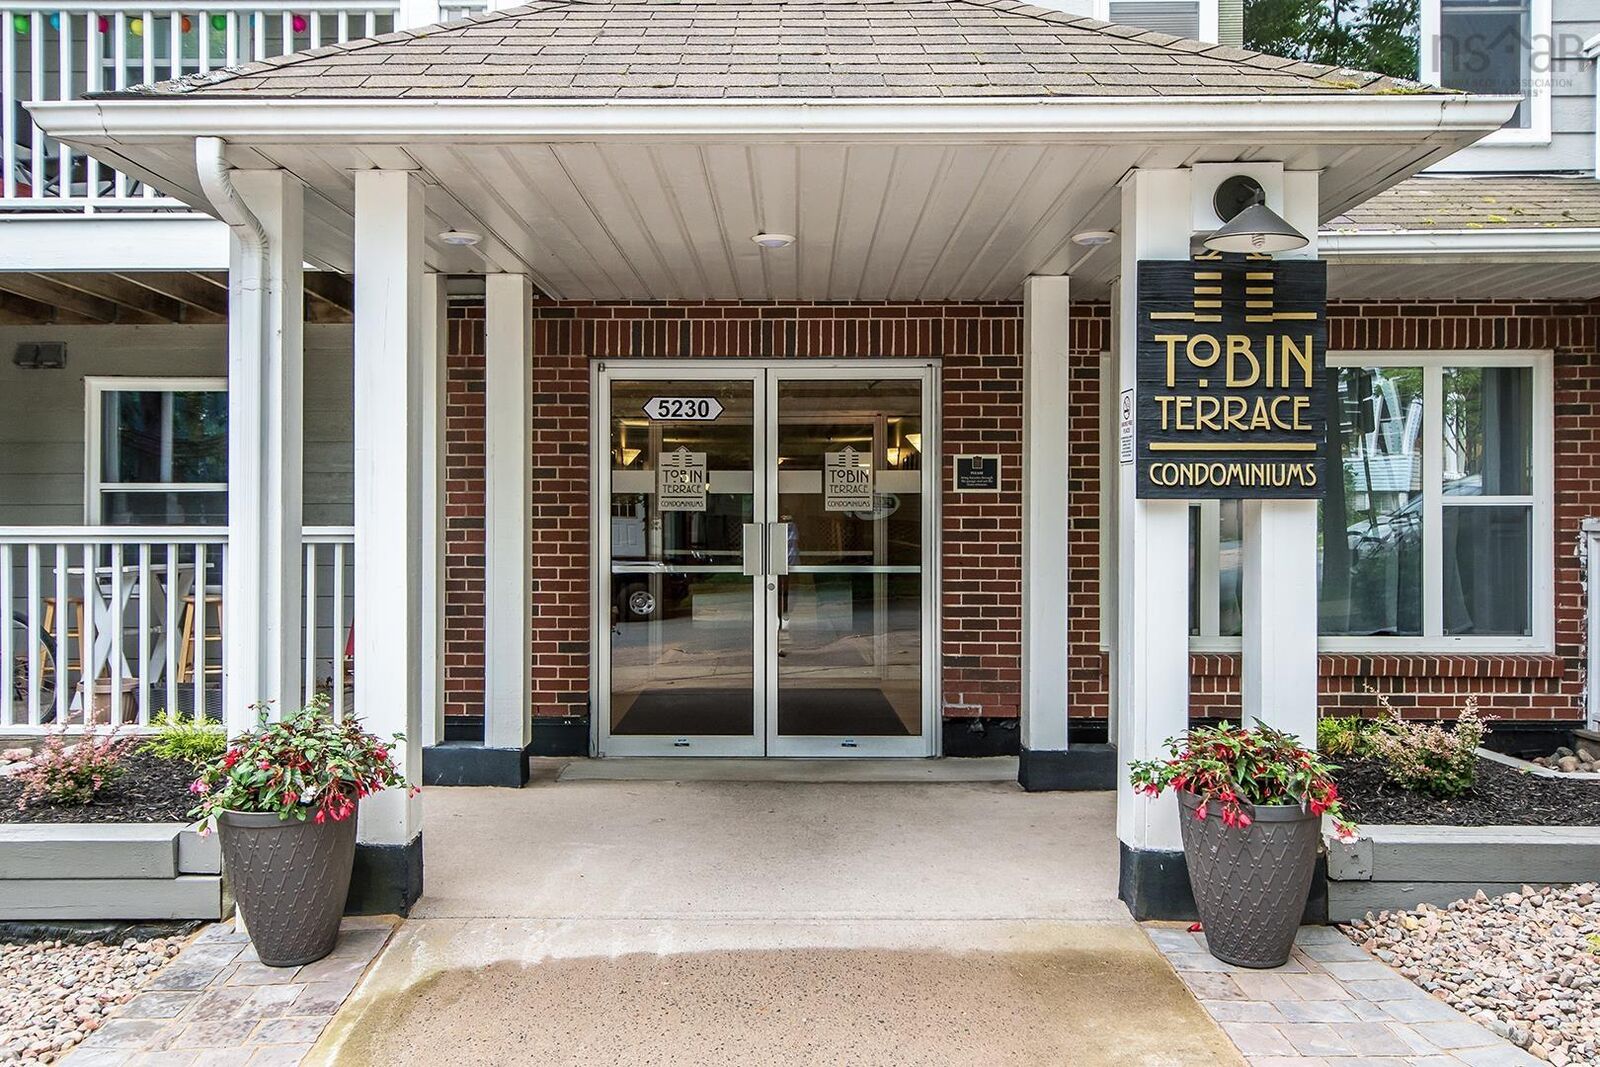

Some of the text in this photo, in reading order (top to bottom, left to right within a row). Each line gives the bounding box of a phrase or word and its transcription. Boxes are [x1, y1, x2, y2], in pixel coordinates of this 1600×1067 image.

[1154, 334, 1313, 388] TOBIN
[658, 399, 710, 418] 5230
[1154, 396, 1313, 431] TERRACE
[662, 469, 703, 484] TOBIN
[829, 469, 869, 484] TOBIN
[1149, 462, 1317, 487] CONDOMINIUMS
[663, 484, 702, 495] TERRACE
[829, 484, 869, 495] TERRACE
[827, 500, 871, 508] CONDOMINIUMS
